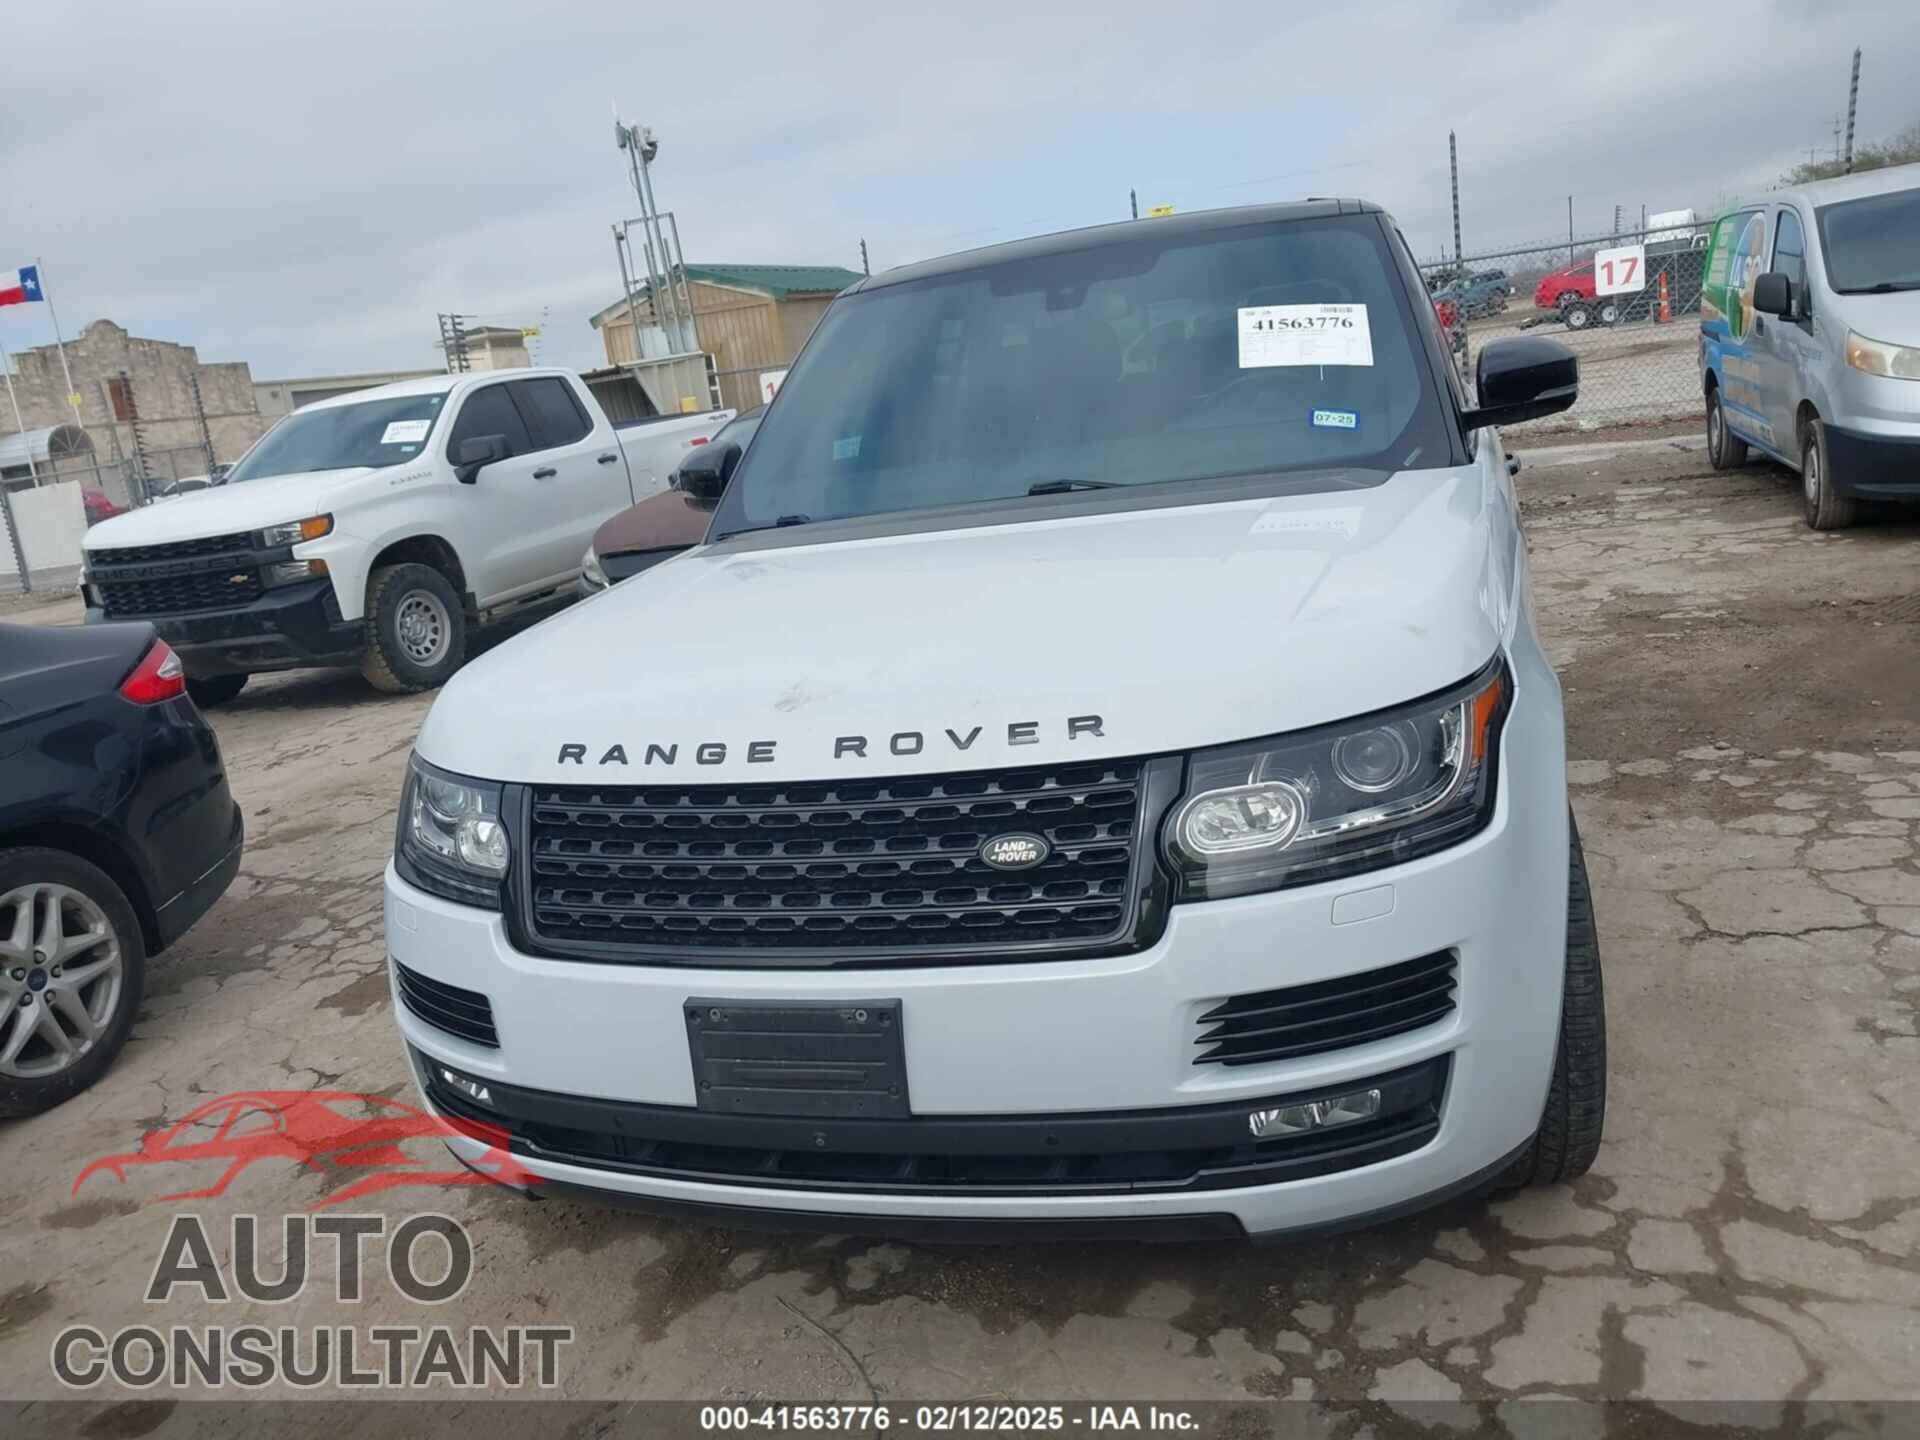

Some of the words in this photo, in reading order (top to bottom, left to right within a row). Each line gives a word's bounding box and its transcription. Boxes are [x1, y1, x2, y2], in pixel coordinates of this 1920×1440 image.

[1601, 257, 1638, 286] 17
[1252, 316, 1353, 331] 41563776
[558, 741, 778, 765] RANGE
[833, 714, 1106, 759] ROVER
